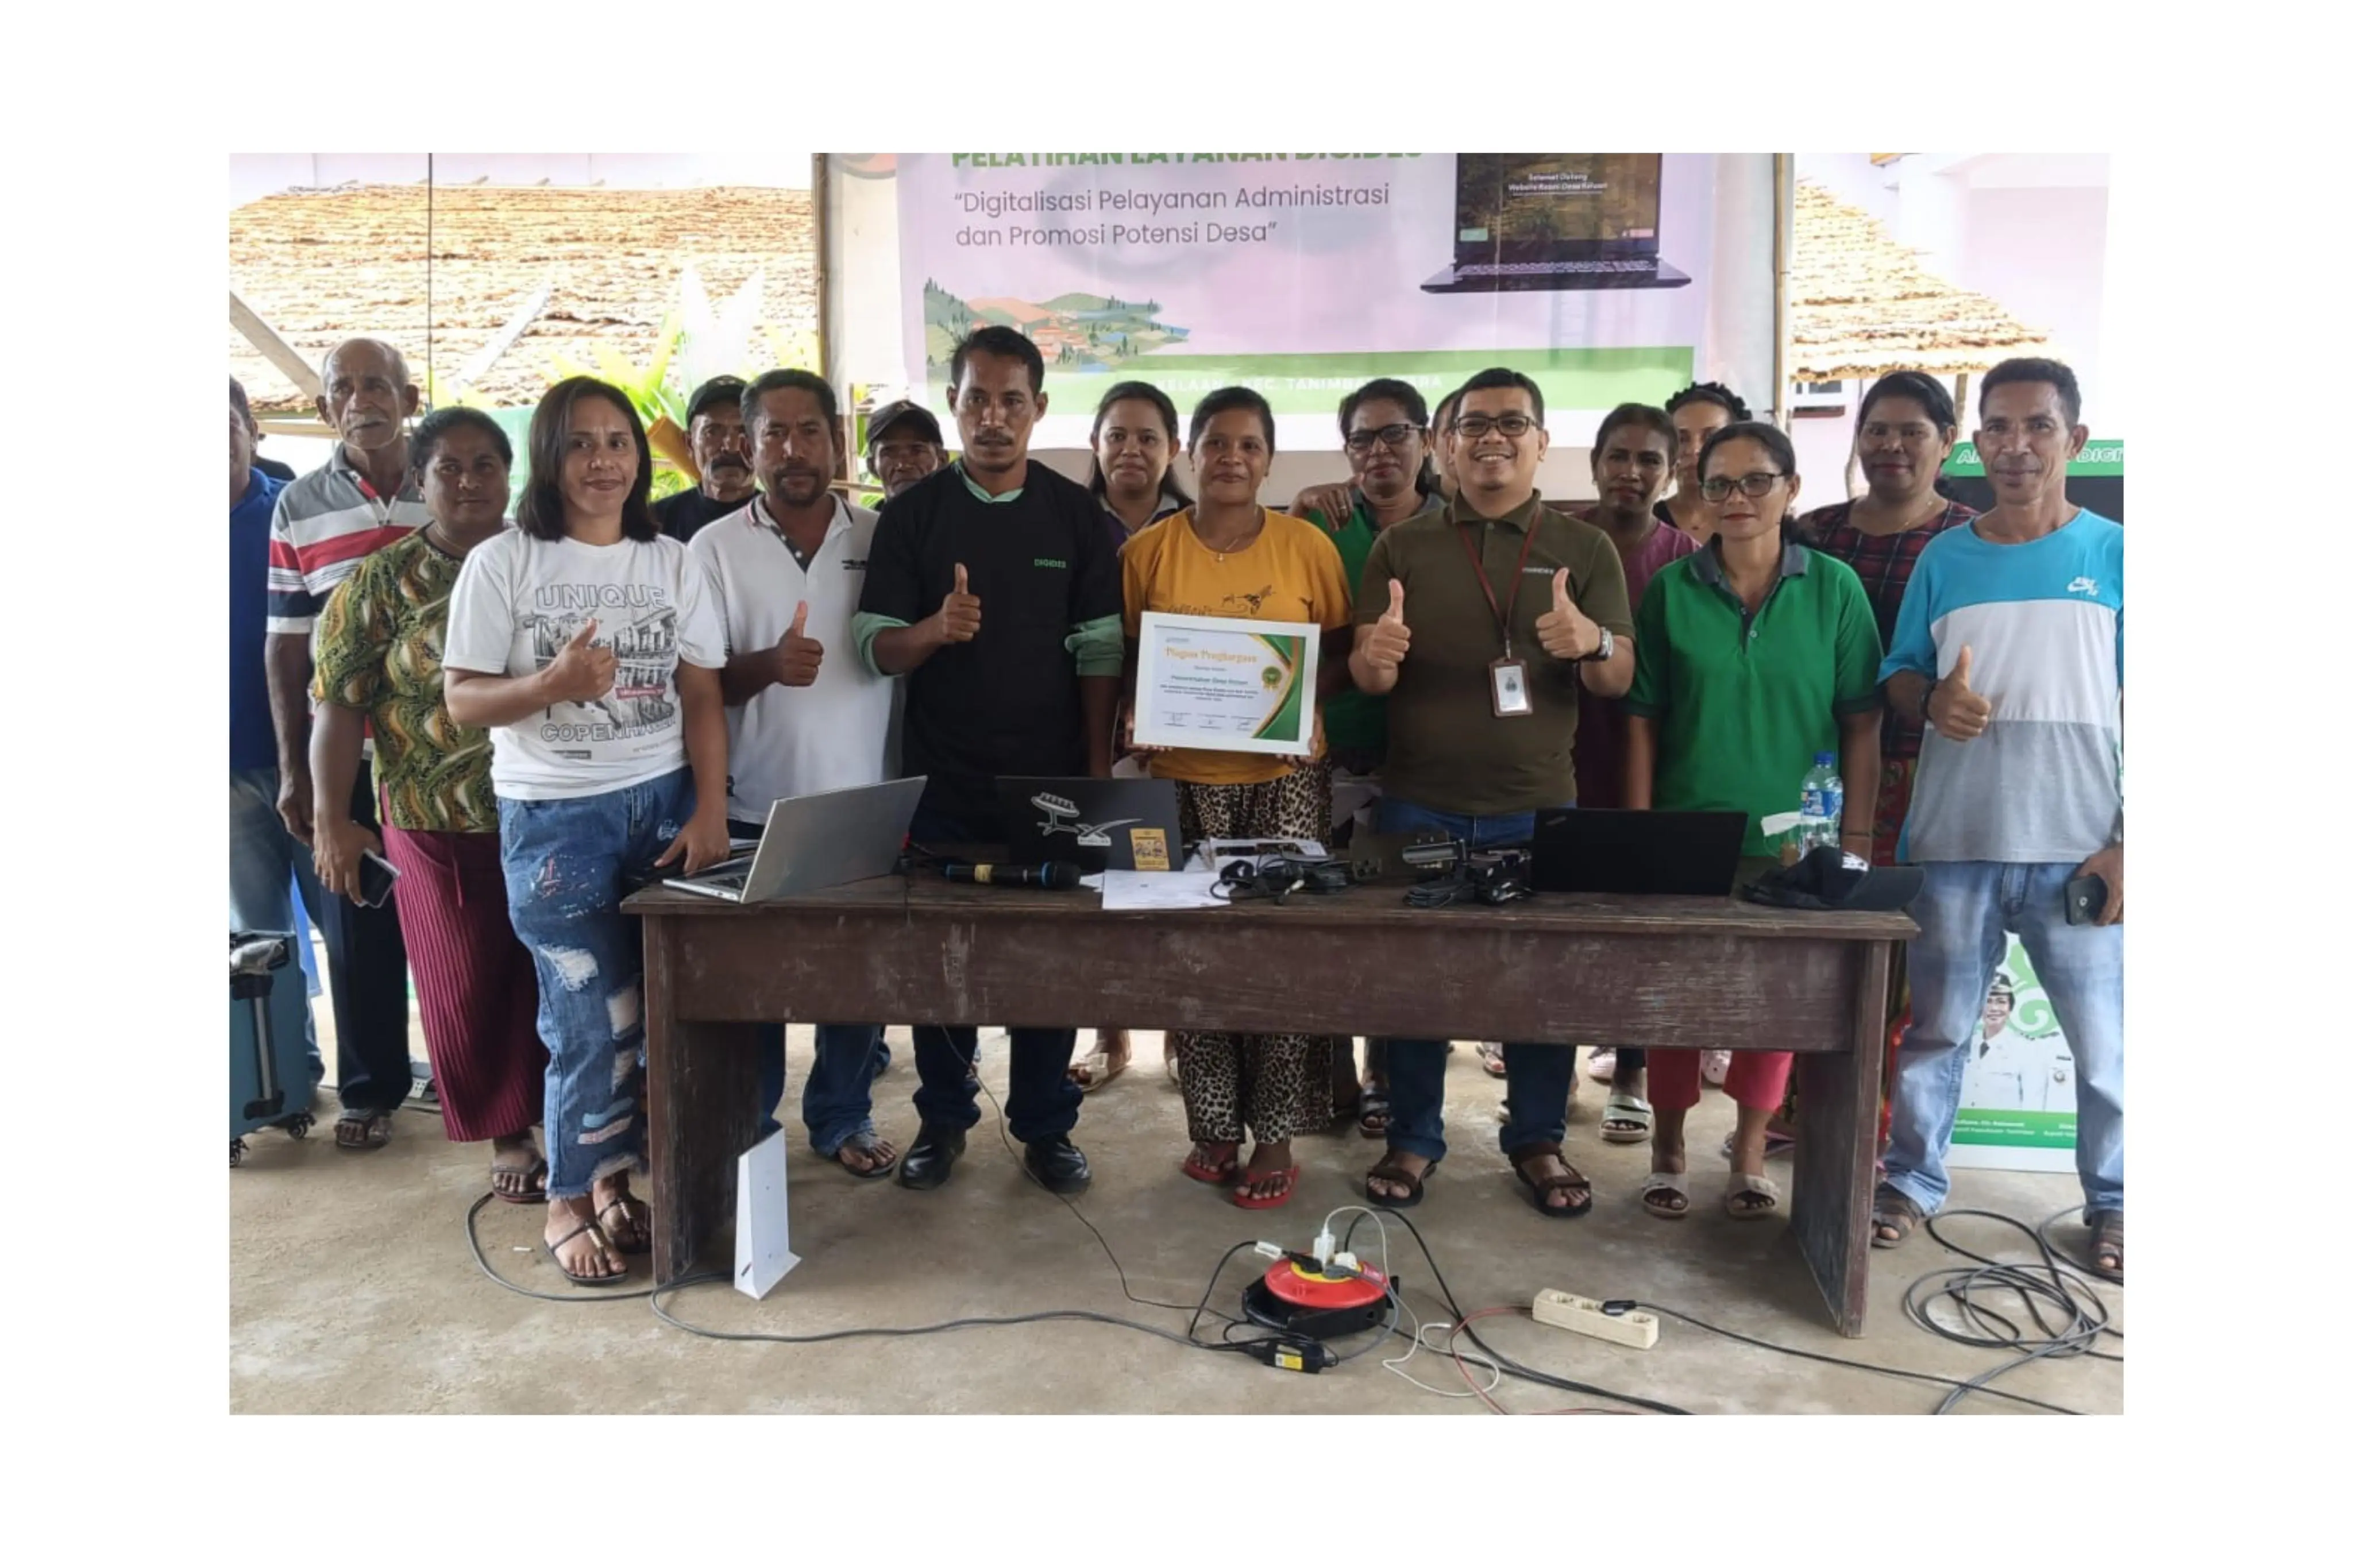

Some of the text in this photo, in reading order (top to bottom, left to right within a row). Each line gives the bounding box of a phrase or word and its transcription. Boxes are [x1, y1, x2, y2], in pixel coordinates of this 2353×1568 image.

[954, 183, 1390, 219] “Digitalisasi Pelayanan Administrasi
[955, 221, 1278, 246] dan Promosi Potensi Desa”
[535, 583, 667, 610] UNIQUE
